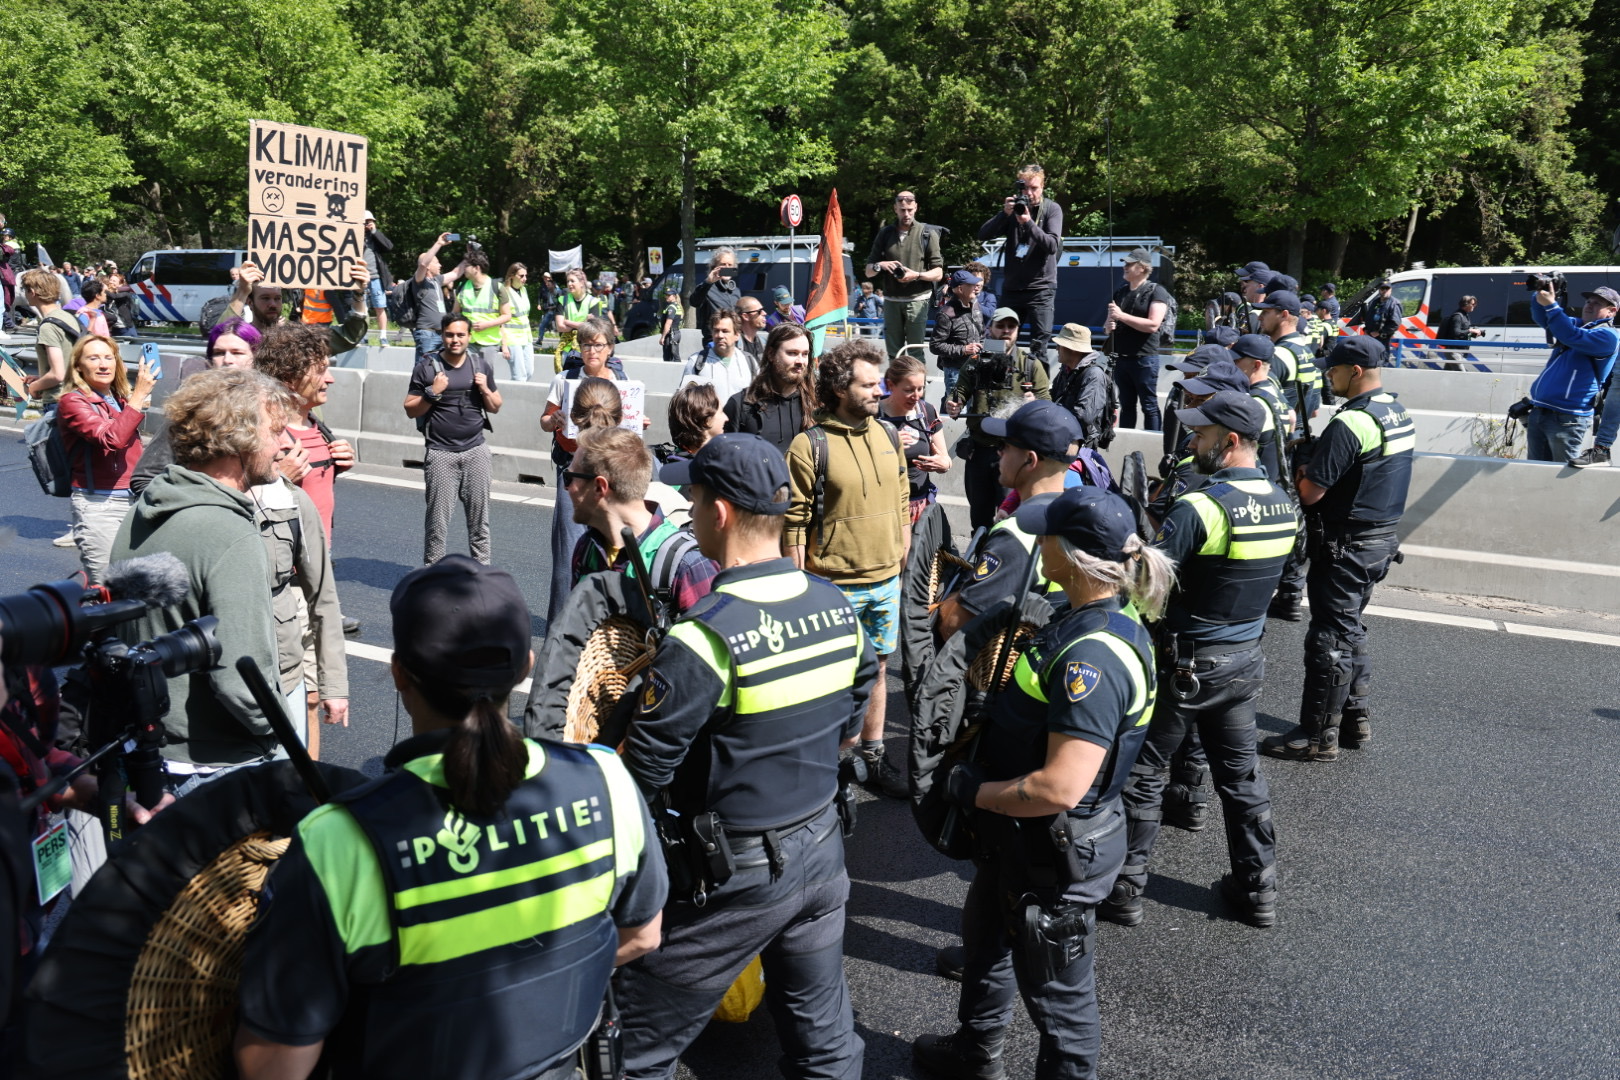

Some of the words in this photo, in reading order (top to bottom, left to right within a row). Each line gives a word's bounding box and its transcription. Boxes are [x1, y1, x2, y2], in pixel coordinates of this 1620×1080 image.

[790, 204, 800, 217] 50
[251, 218, 361, 258] MASSA
[250, 251, 356, 288] MOORD
[745, 609, 843, 654] POLITIE
[109, 804, 118, 829] Nikon
[37, 832, 66, 863] PERS
[412, 799, 592, 874] POLITIE
